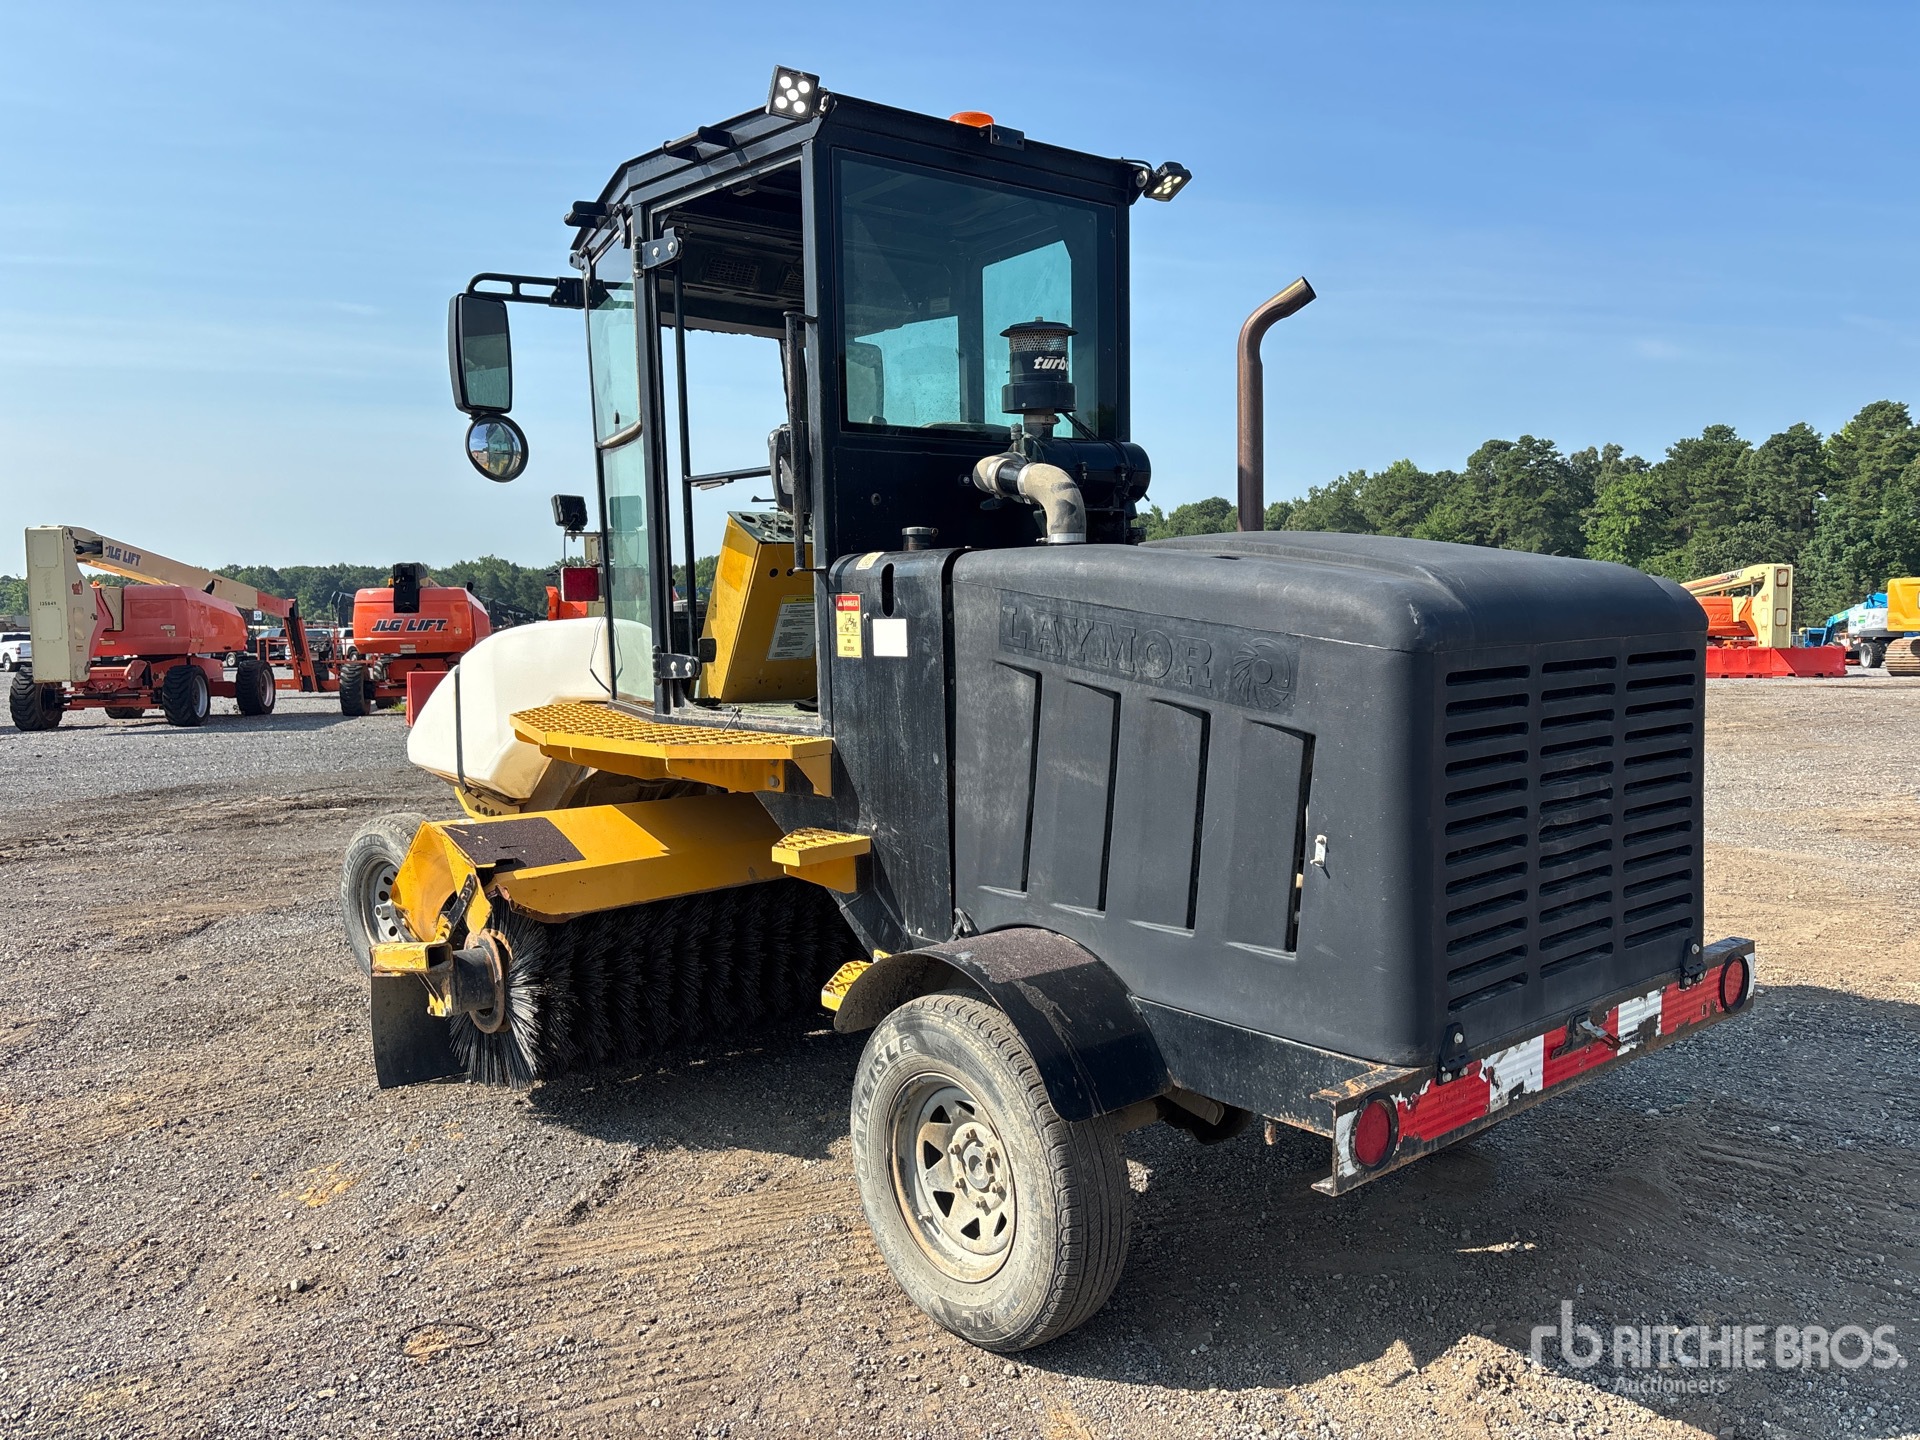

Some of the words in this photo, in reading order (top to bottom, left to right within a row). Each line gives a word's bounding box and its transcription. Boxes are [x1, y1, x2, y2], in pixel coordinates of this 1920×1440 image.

[106, 545, 121, 561] JLG
[122, 550, 141, 567] LIFT
[371, 619, 403, 632] JLG
[405, 619, 447, 632] LIFT
[1001, 604, 1213, 688] LAYMOR
[855, 1034, 913, 1179] CARLISLE
